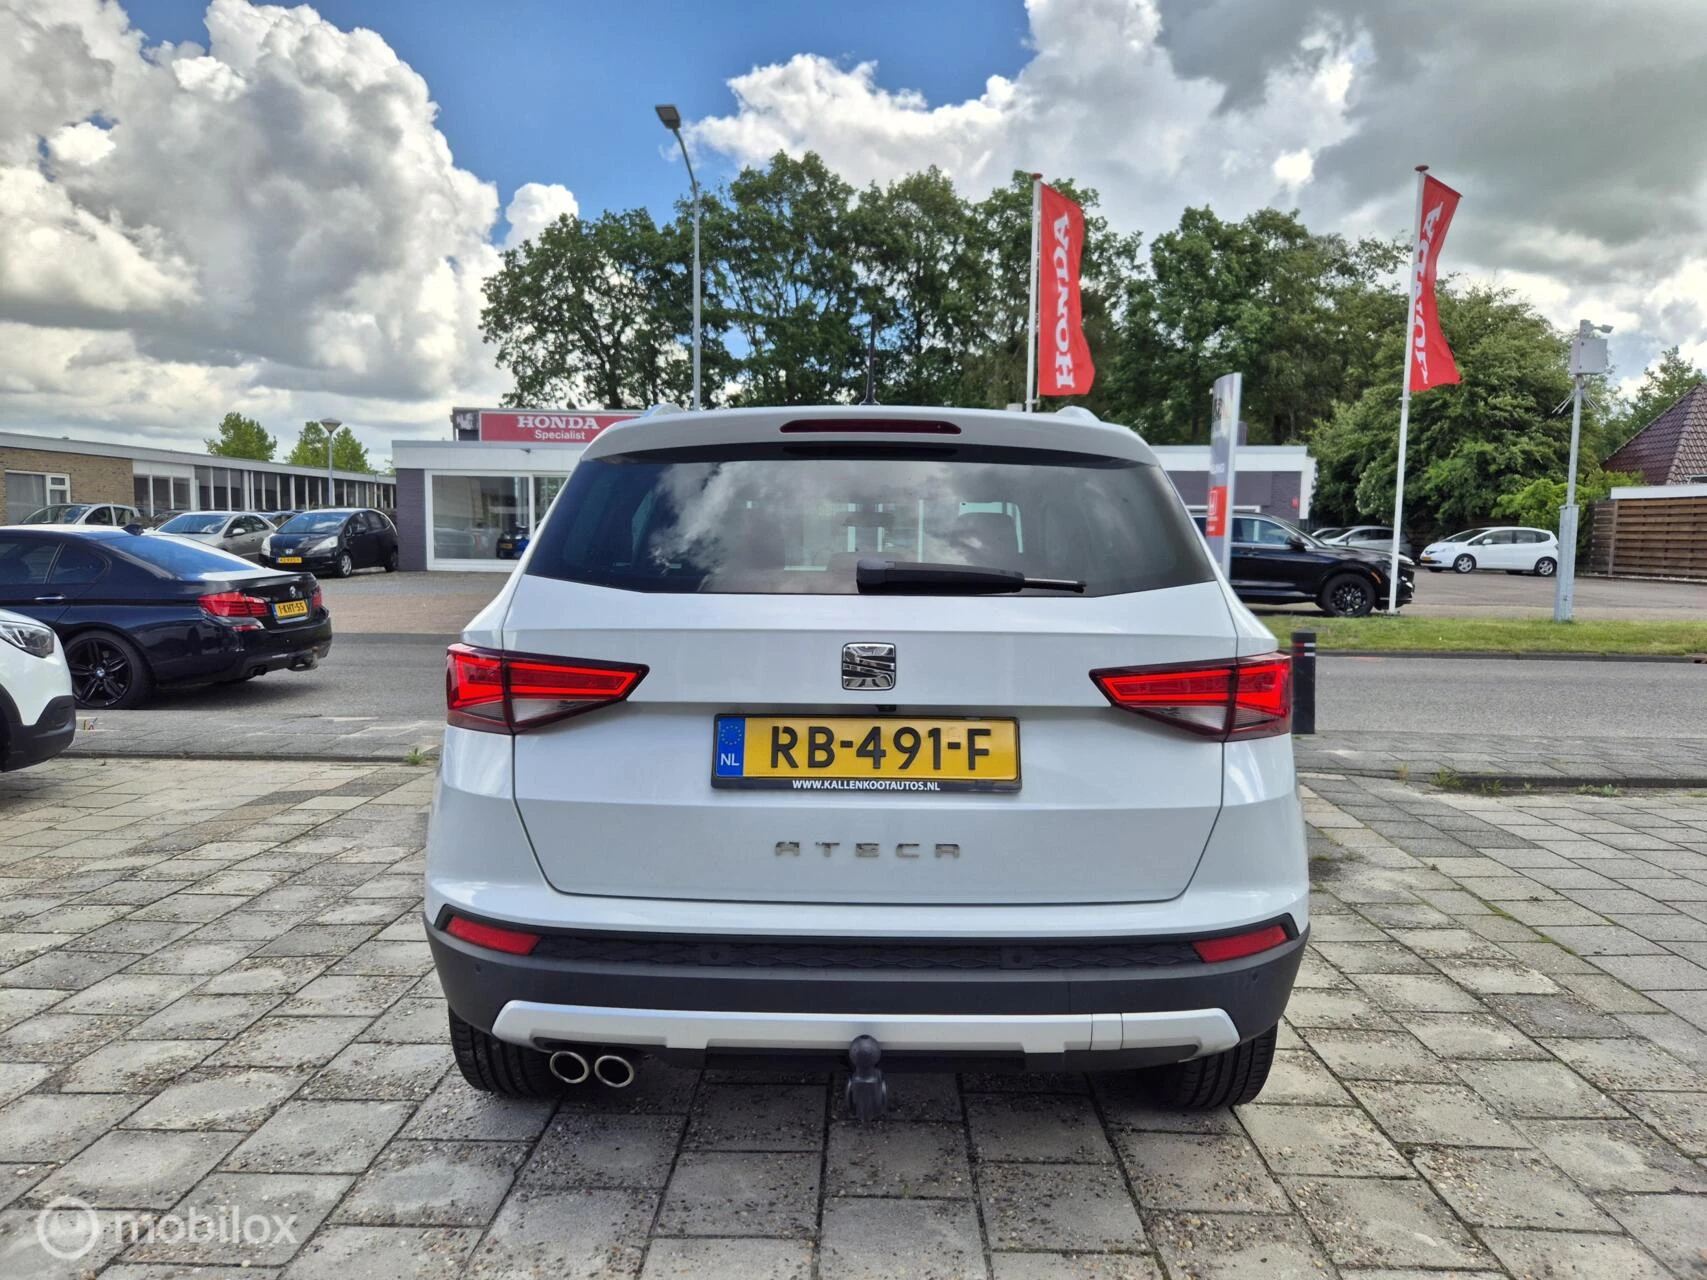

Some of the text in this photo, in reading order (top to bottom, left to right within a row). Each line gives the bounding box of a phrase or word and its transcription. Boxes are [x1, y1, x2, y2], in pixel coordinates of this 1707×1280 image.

[1053, 211, 1075, 389] HONDA
[517, 415, 600, 429] HONDA
[535, 430, 586, 440] Specialist
[770, 725, 992, 770] RB-491-F
[720, 752, 740, 766] NL
[792, 779, 941, 791] WWW.KALLENKOOTAUTOS.NL
[775, 841, 960, 859] ATECA
